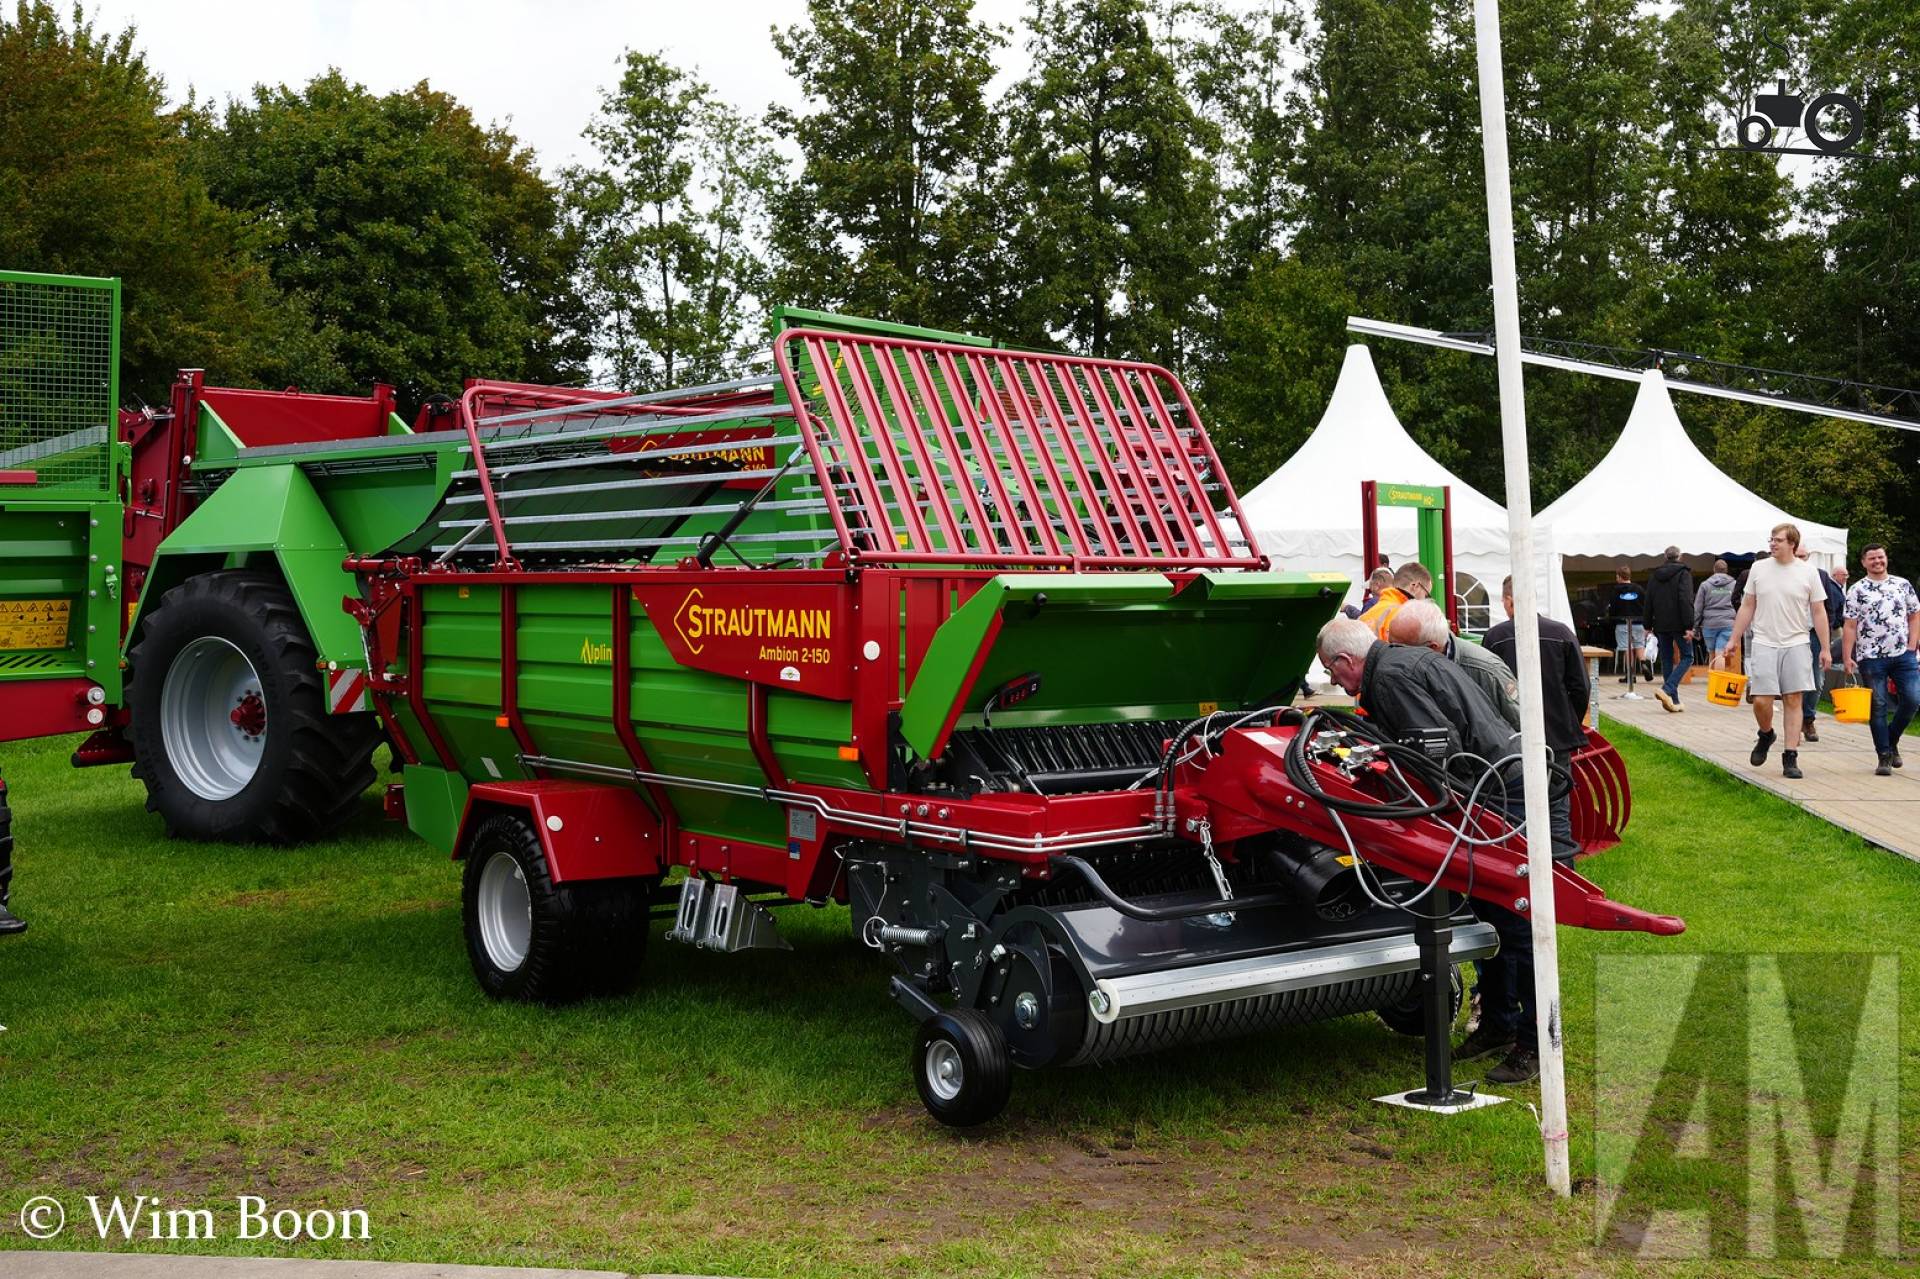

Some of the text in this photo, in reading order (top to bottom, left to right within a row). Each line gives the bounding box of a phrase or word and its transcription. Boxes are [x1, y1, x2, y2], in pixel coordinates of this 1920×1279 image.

[688, 604, 831, 639] STRAUTMANN
[759, 645, 830, 664] Ambion 2-150
